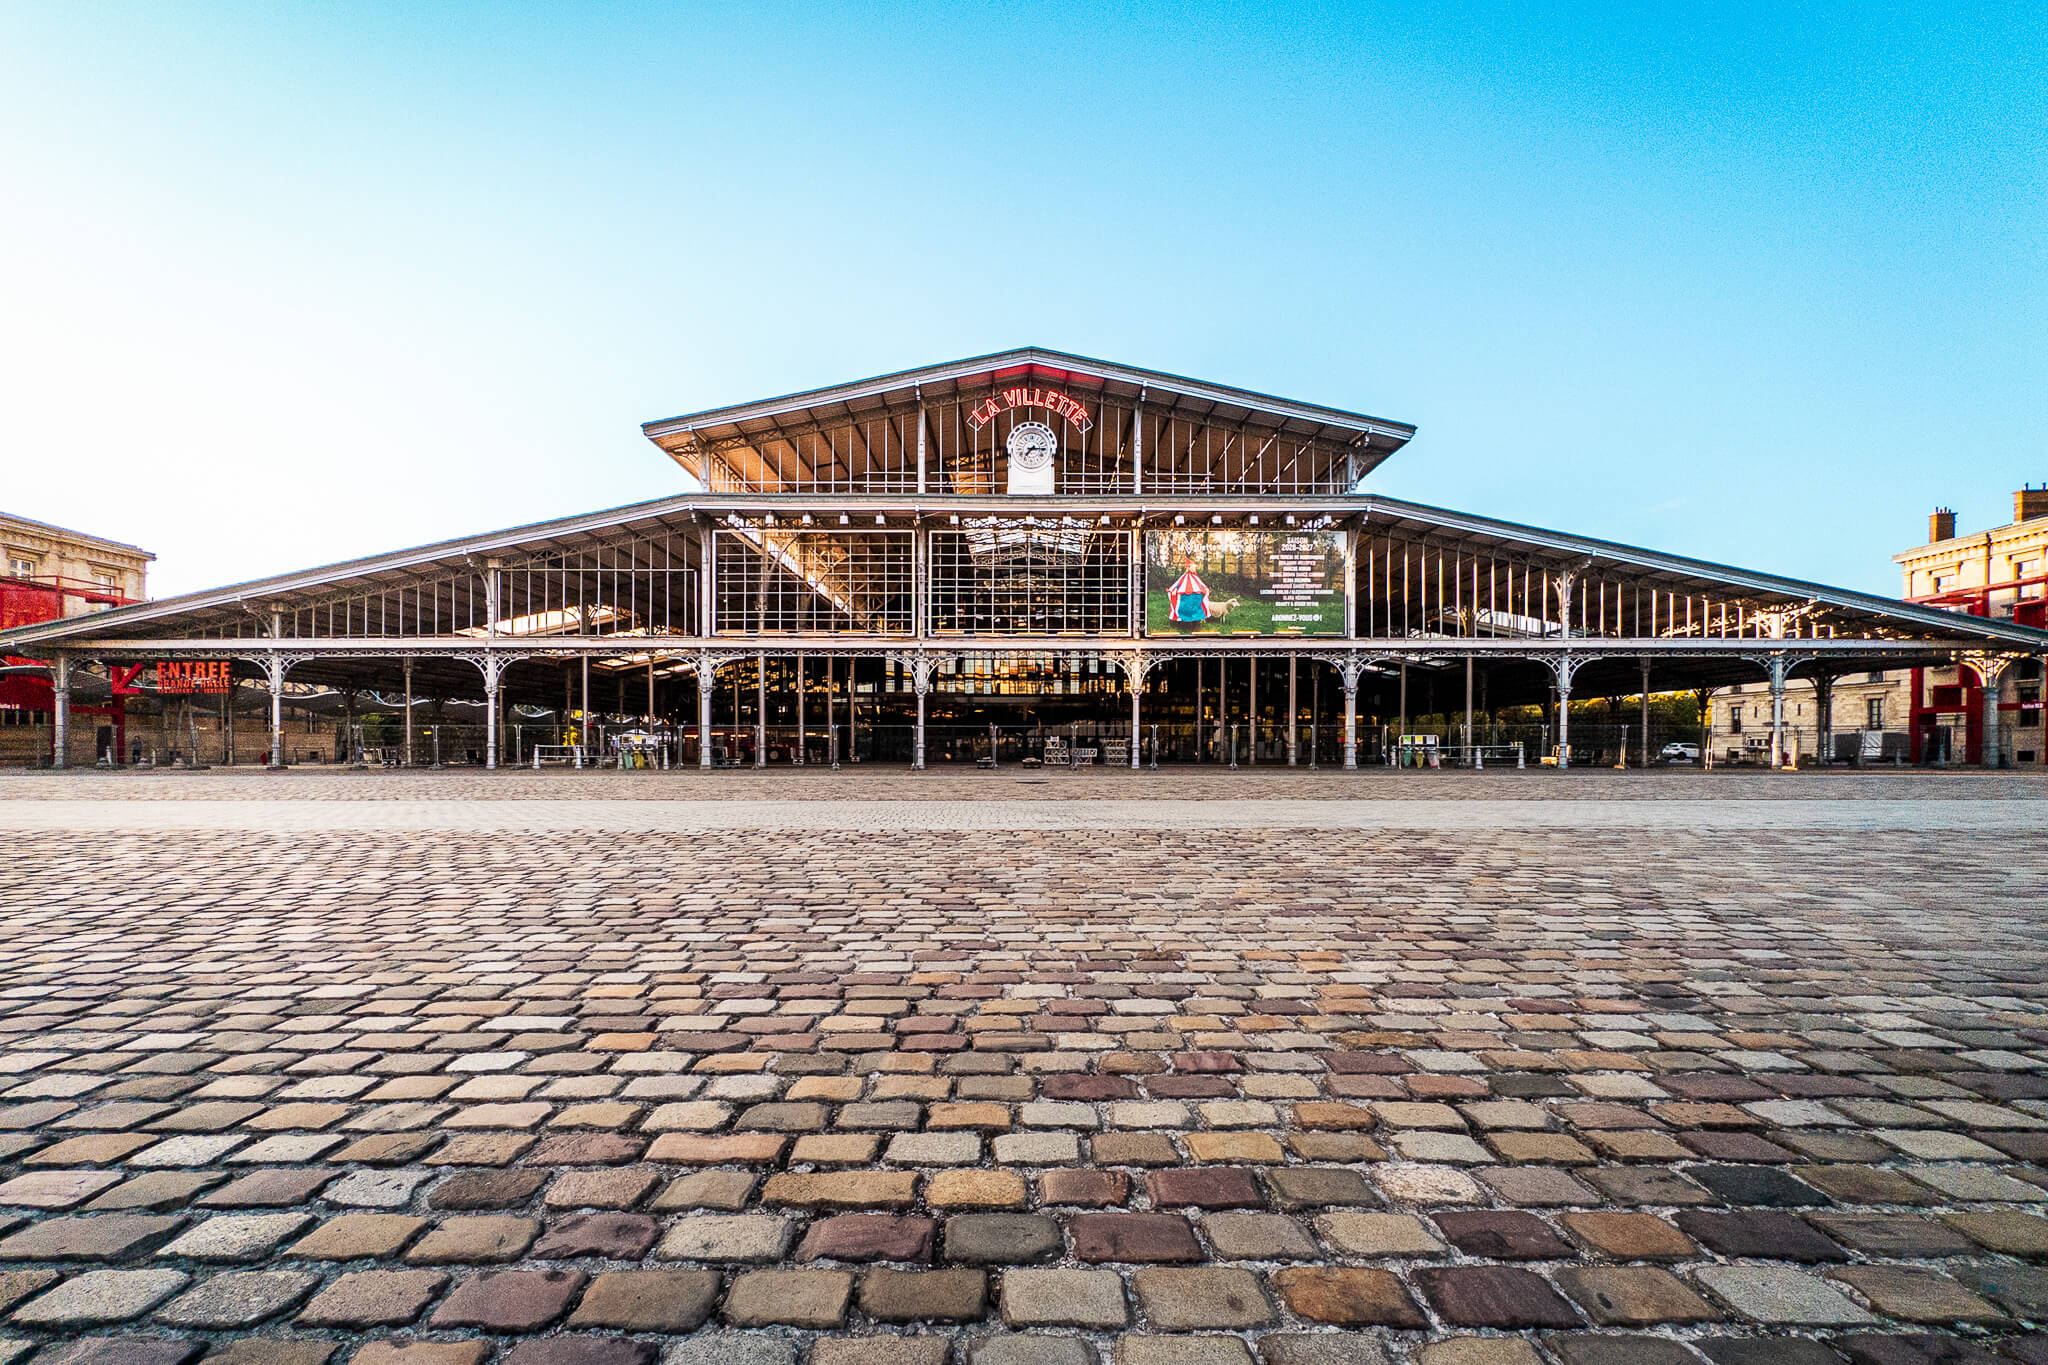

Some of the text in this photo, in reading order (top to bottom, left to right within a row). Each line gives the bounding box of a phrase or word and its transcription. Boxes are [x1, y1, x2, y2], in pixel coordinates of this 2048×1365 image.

[971, 388, 1089, 426] LA VILLETTE
[157, 662, 230, 678] ENTREE
[157, 679, 230, 688] GRANDE HALLE
